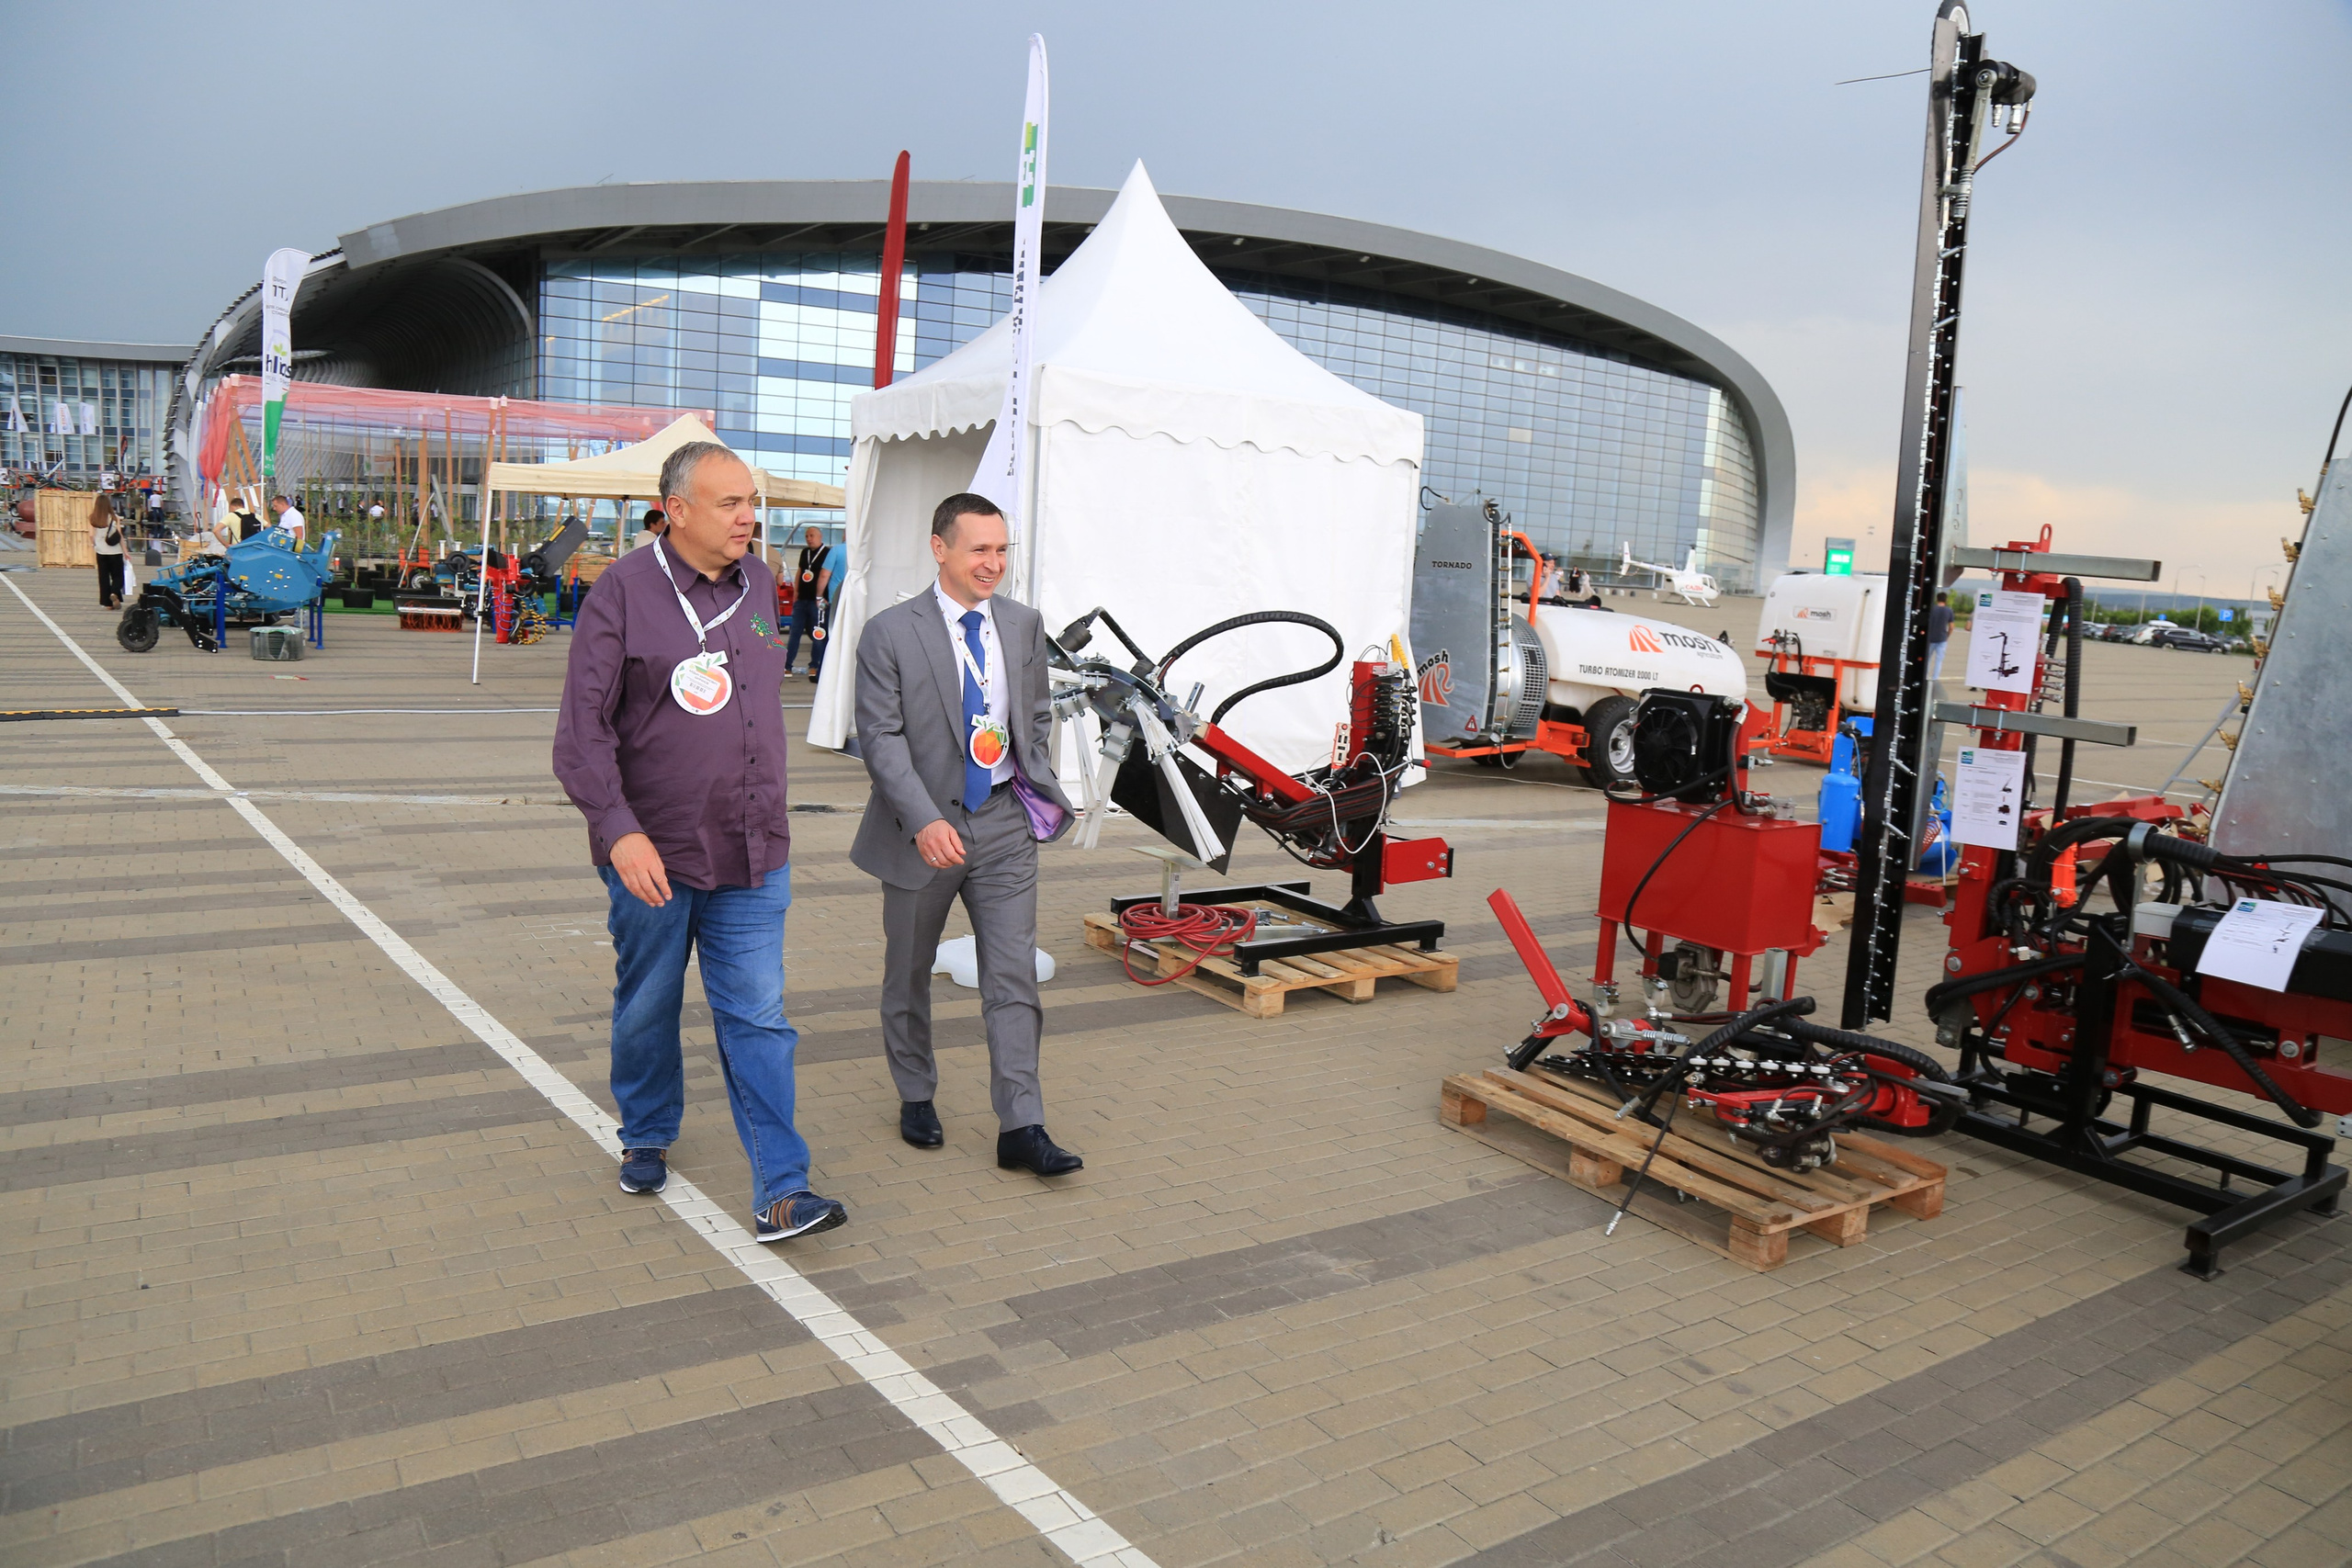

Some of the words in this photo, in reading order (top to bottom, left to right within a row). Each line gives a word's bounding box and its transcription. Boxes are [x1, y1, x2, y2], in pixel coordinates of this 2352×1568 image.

[1431, 560, 1473, 570] TORNADO
[1810, 610, 1832, 618] mosh
[2222, 610, 2232, 621] P
[1659, 631, 1721, 654] mosh
[1417, 649, 1449, 677] mosh
[1578, 664, 1603, 675] TURBO
[1604, 667, 1636, 679] ATOMIZER
[1636, 671, 1652, 681] 2000
[1652, 672, 1659, 682] LT
